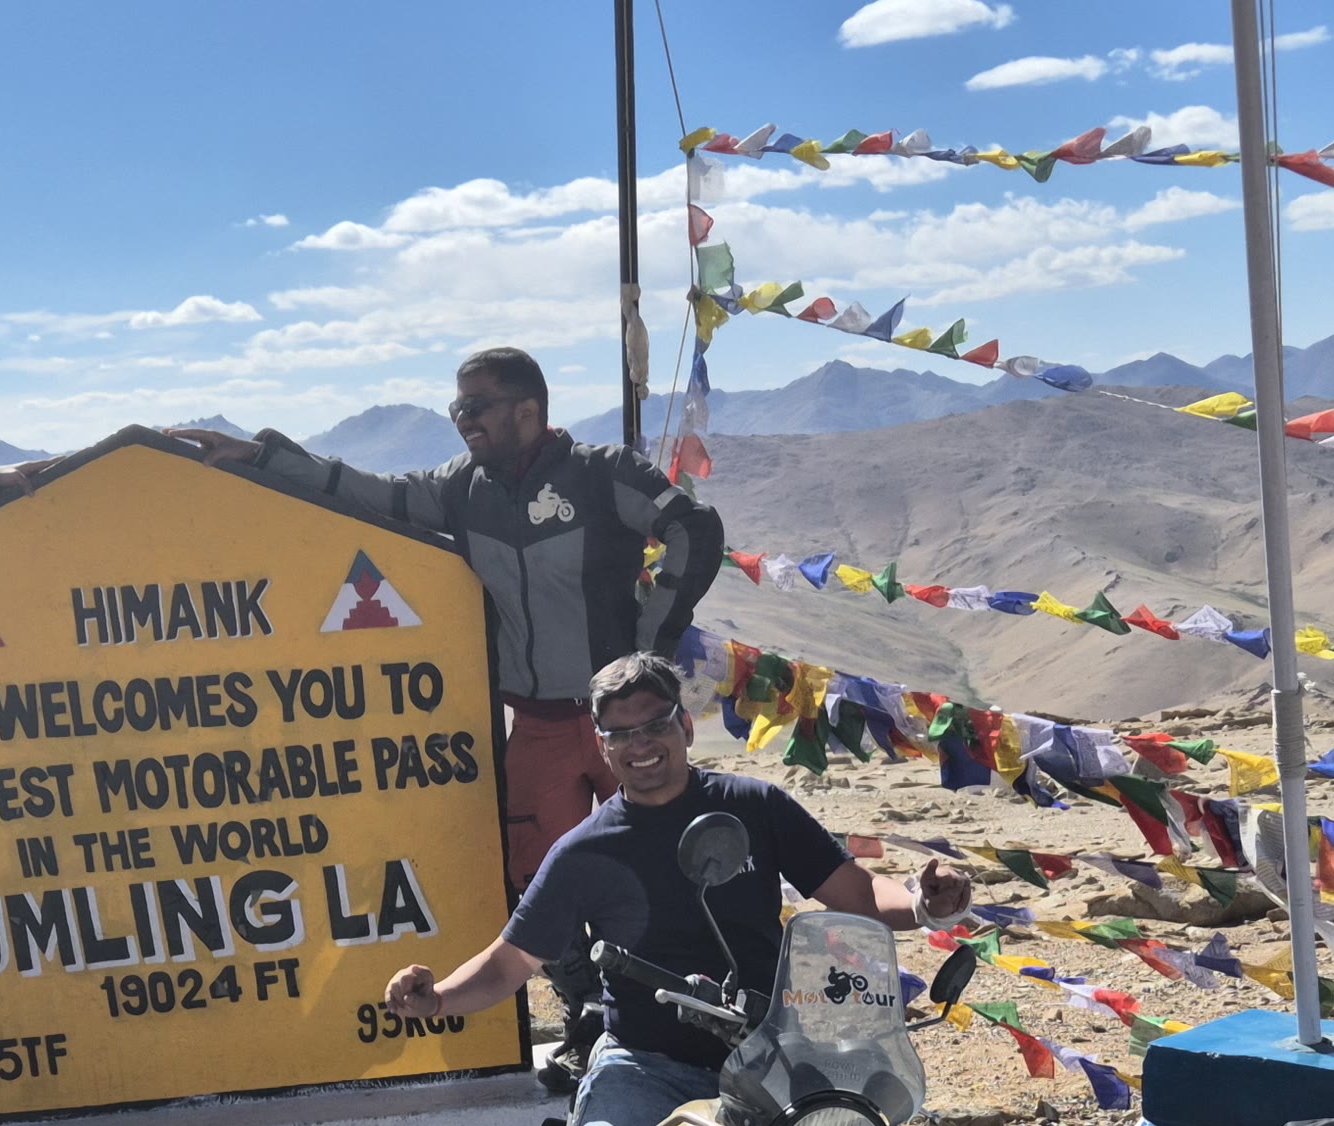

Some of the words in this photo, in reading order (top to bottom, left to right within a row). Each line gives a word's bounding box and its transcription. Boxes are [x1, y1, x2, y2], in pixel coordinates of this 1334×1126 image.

[71, 577, 274, 647] HIMANK
[266, 663, 367, 723] YOU
[380, 661, 445, 716] TO
[92, 739, 364, 814] MOTORABLE
[370, 730, 480, 791] PASS
[16, 835, 60, 879] IN
[72, 827, 156, 874] THE
[170, 813, 330, 866] WORLD
[322, 857, 440, 948] LA
[99, 960, 244, 1018] 19024
[253, 957, 302, 1002] FT
